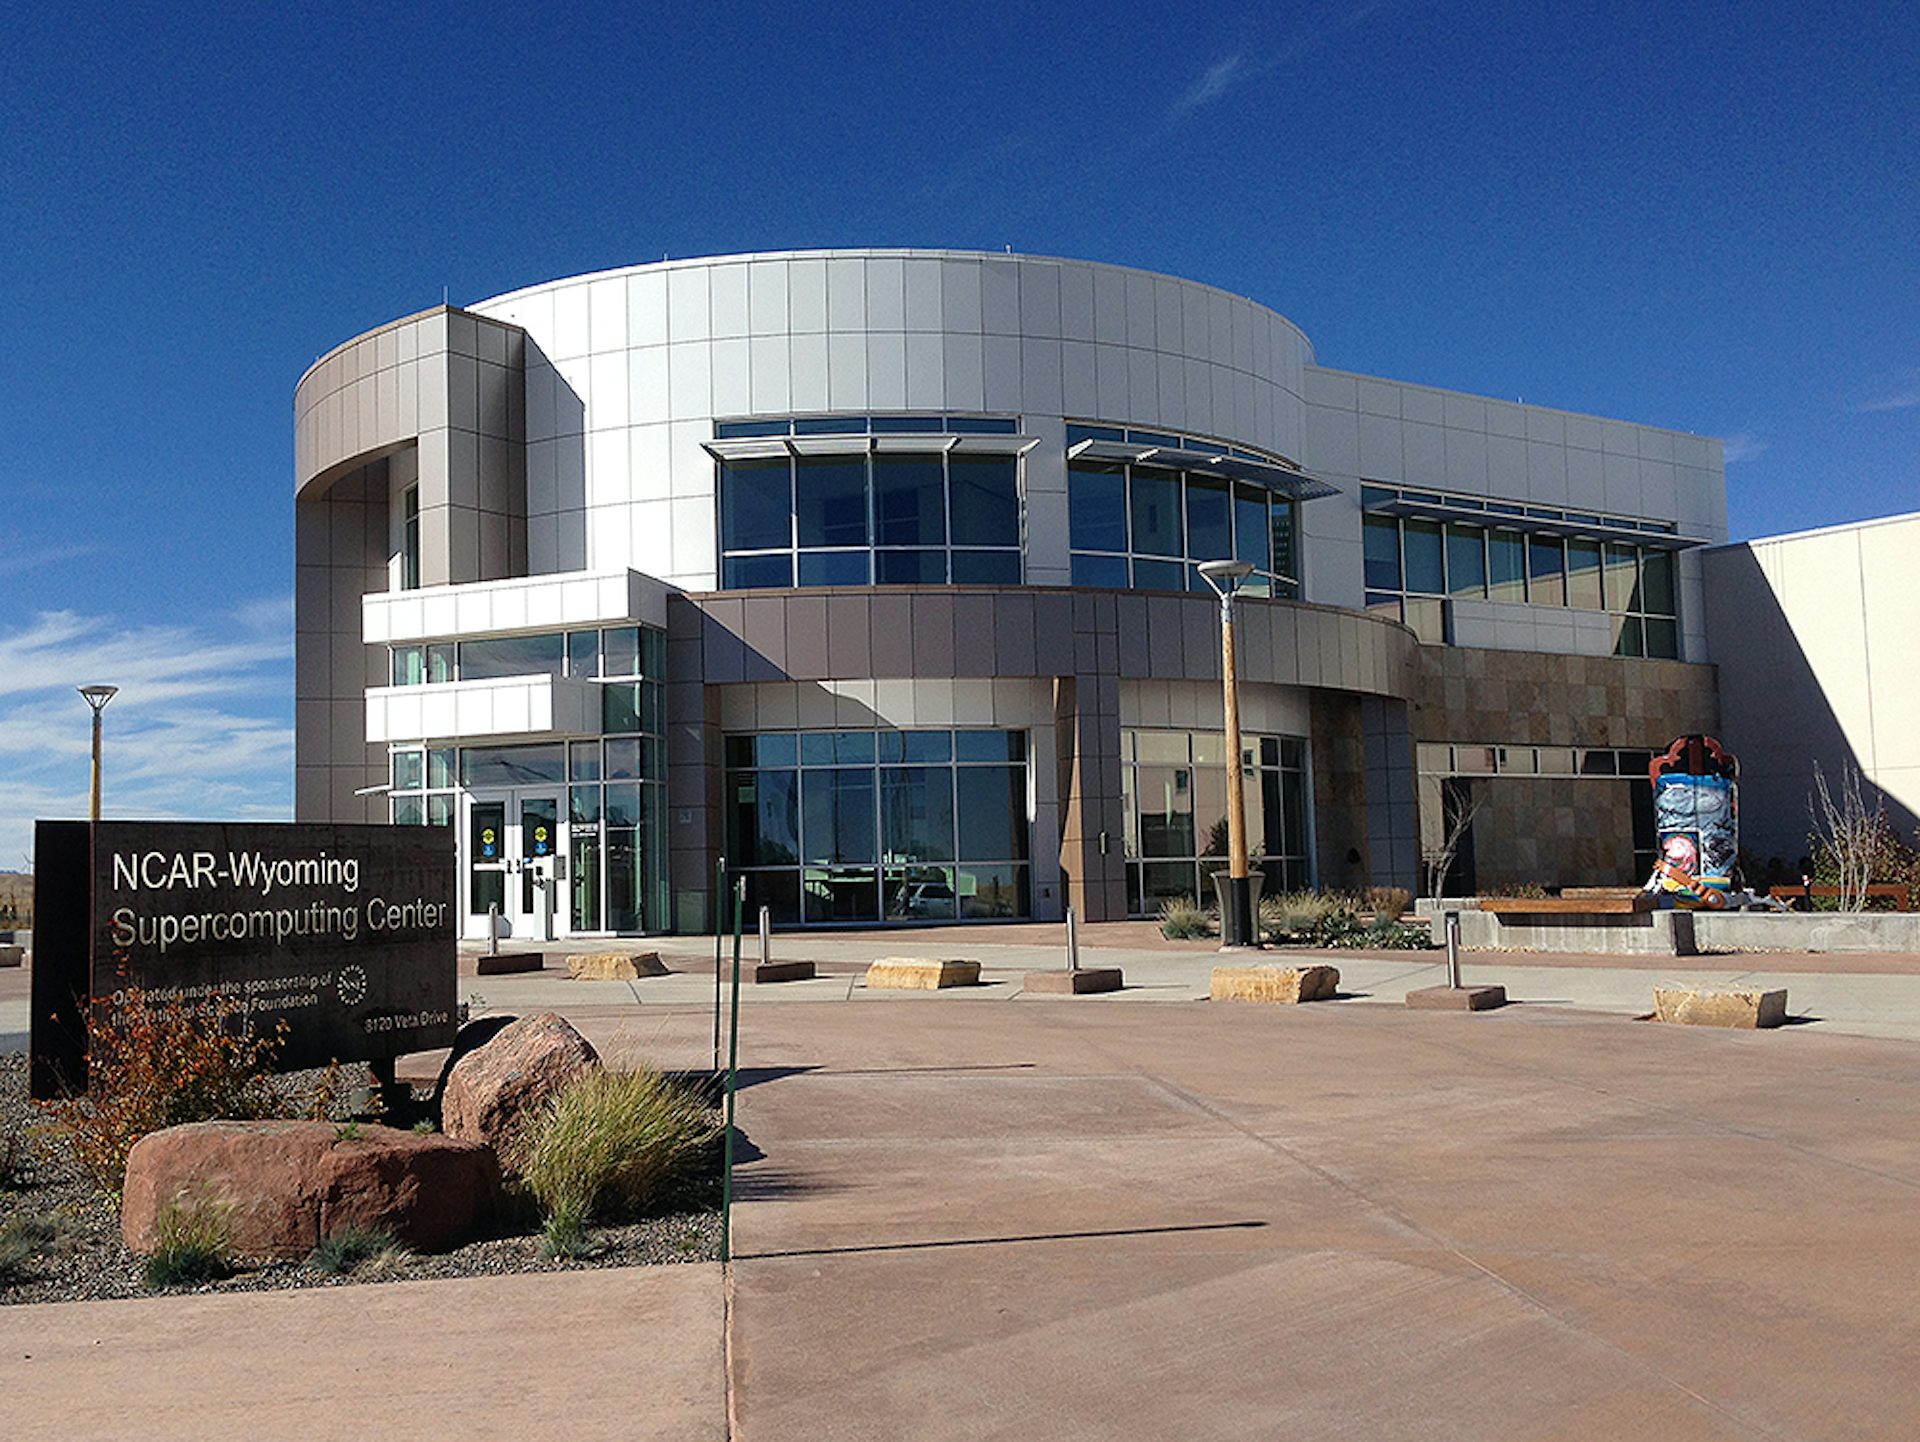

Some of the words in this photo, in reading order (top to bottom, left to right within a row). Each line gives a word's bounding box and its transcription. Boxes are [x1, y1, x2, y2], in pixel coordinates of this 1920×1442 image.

[113, 851, 359, 896] NCAR-Wyoming
[112, 901, 358, 953] Supercomputing
[367, 898, 446, 931] Center
[244, 975, 319, 996] sponsorship
[320, 971, 333, 987] of
[251, 994, 319, 1012] Foundation
[420, 1010, 448, 1026] Drive
